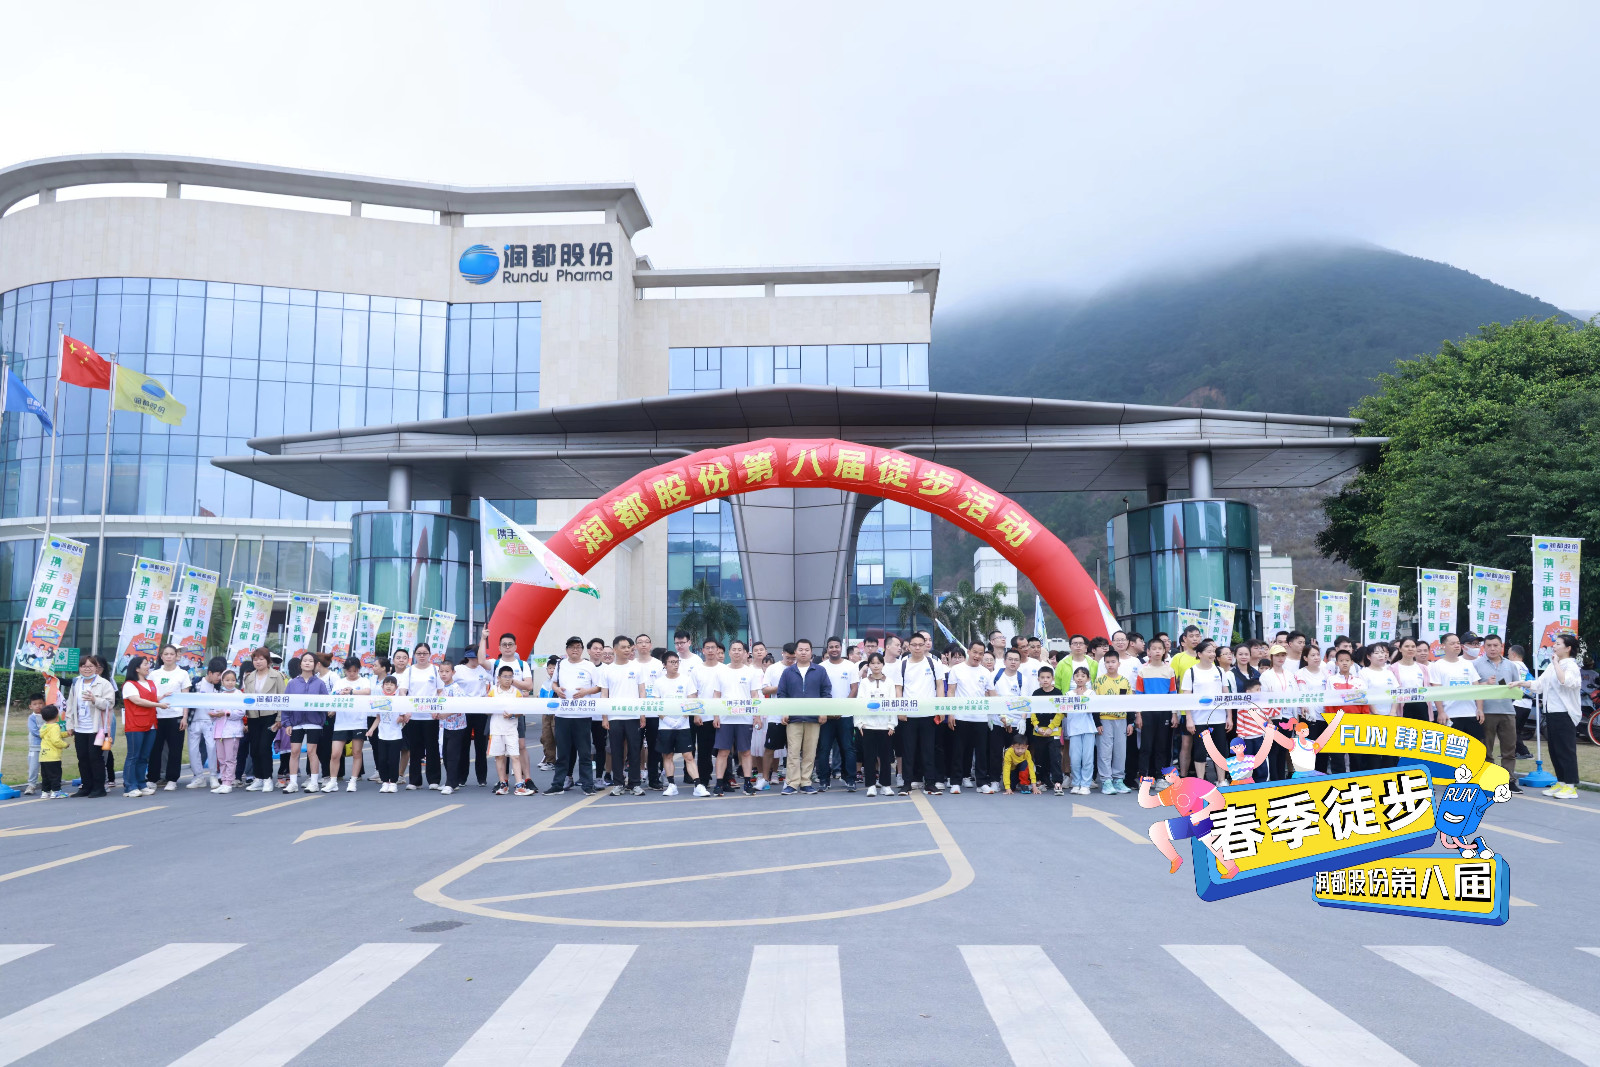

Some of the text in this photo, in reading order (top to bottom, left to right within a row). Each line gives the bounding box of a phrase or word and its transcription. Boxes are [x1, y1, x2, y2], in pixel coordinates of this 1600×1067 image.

[502, 269, 613, 284] Rundu Pharma
[503, 242, 613, 268] 润都股份
[573, 447, 1033, 554] 润都股份第八届徒步活动
[497, 528, 521, 540] 携手
[507, 542, 534, 555] 绿色
[35, 556, 62, 608] 携手润都
[46, 572, 73, 626] 绿色同行
[133, 576, 150, 624] 携手润都
[183, 583, 200, 627] 携手润都
[1543, 558, 1554, 611] 携手润都
[1560, 572, 1572, 626] 绿色同行
[145, 590, 163, 638] 绿色同行
[1368, 598, 1380, 640] 携手润都
[1427, 586, 1437, 632] 携手润都
[1476, 585, 1488, 634] 携手润都
